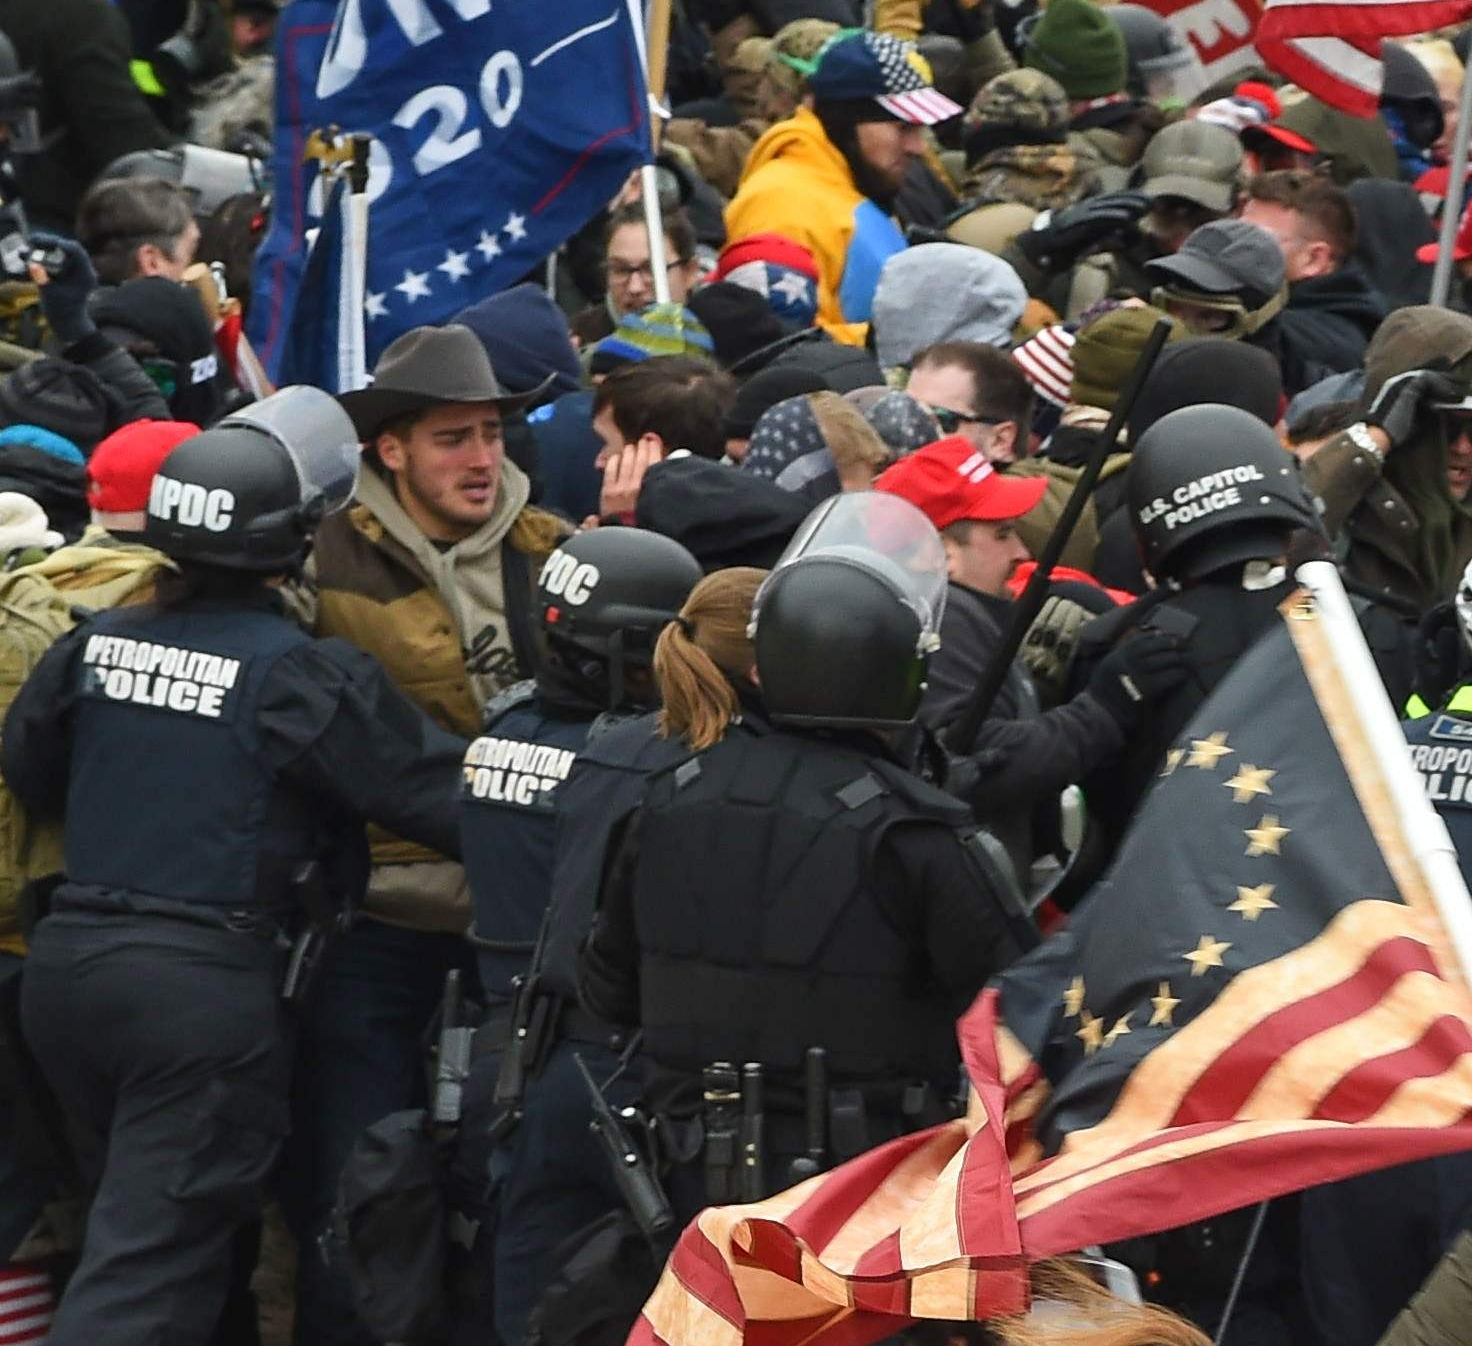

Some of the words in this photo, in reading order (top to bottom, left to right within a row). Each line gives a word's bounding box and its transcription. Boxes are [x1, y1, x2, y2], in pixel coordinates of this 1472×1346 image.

[1140, 497, 1173, 524] U.S.
[1172, 464, 1265, 505] CAPITOL
[1163, 486, 1242, 530] POLICE
[82, 633, 241, 690] METROPOLITAN
